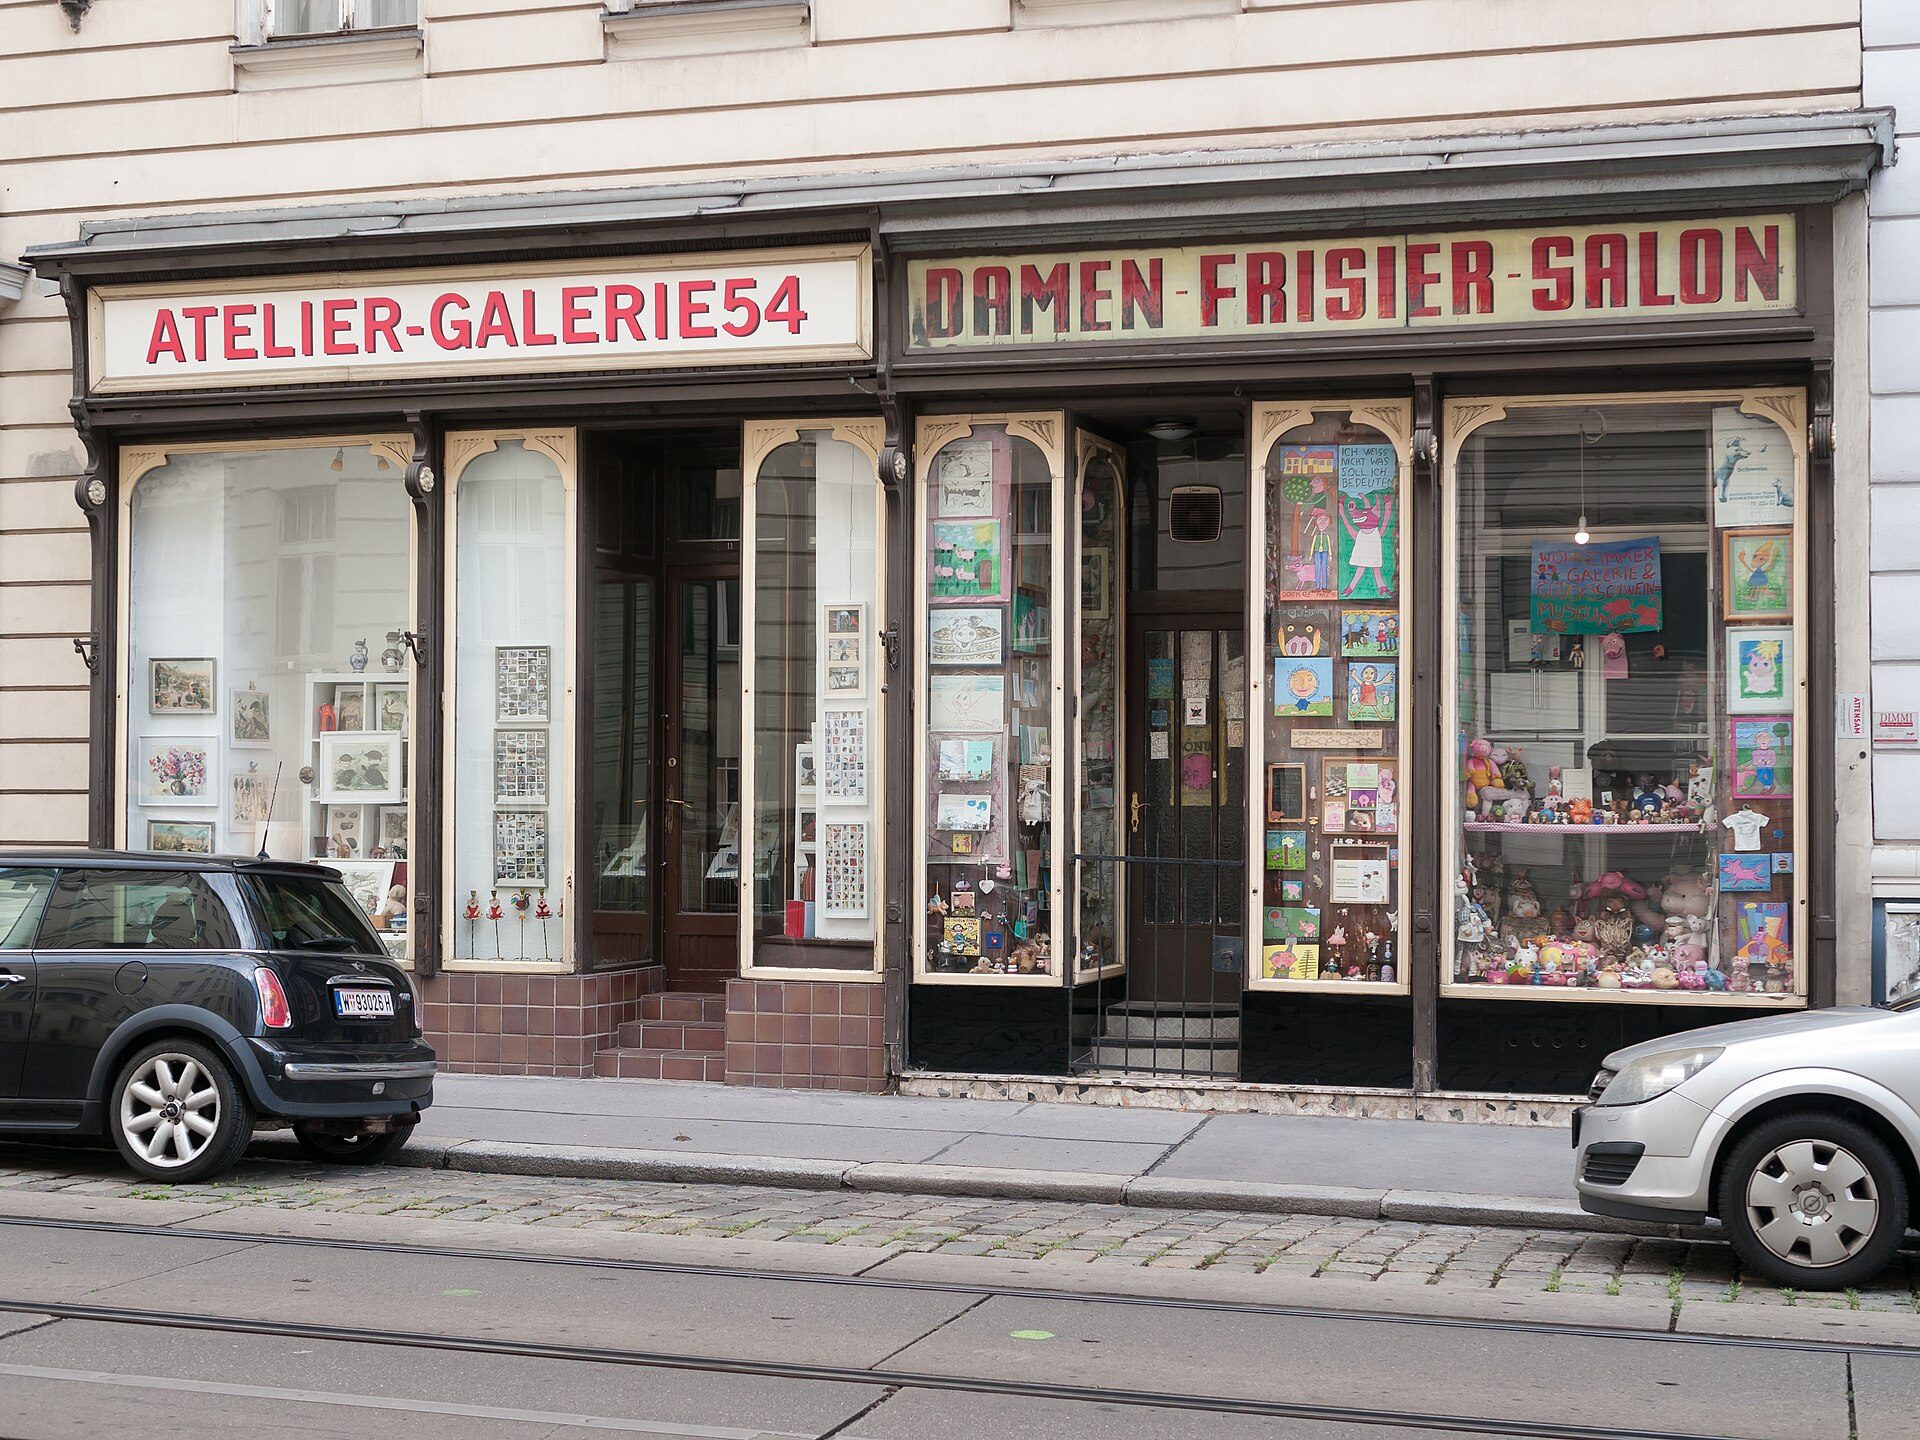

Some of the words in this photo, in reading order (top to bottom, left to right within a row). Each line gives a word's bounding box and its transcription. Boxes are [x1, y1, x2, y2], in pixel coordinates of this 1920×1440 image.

[1341, 447, 1358, 456] ICH
[1363, 447, 1388, 456] WEISS
[1340, 457, 1365, 466] NICHT
[1370, 456, 1389, 466] WAS
[1341, 468, 1367, 477] SOLL
[1370, 467, 1388, 476] ICH
[1539, 546, 1655, 564] WOHNZIMMER
[1566, 566, 1638, 583] GALERIE
[1642, 563, 1656, 580] &
[1880, 713, 1913, 722] DIMMI
